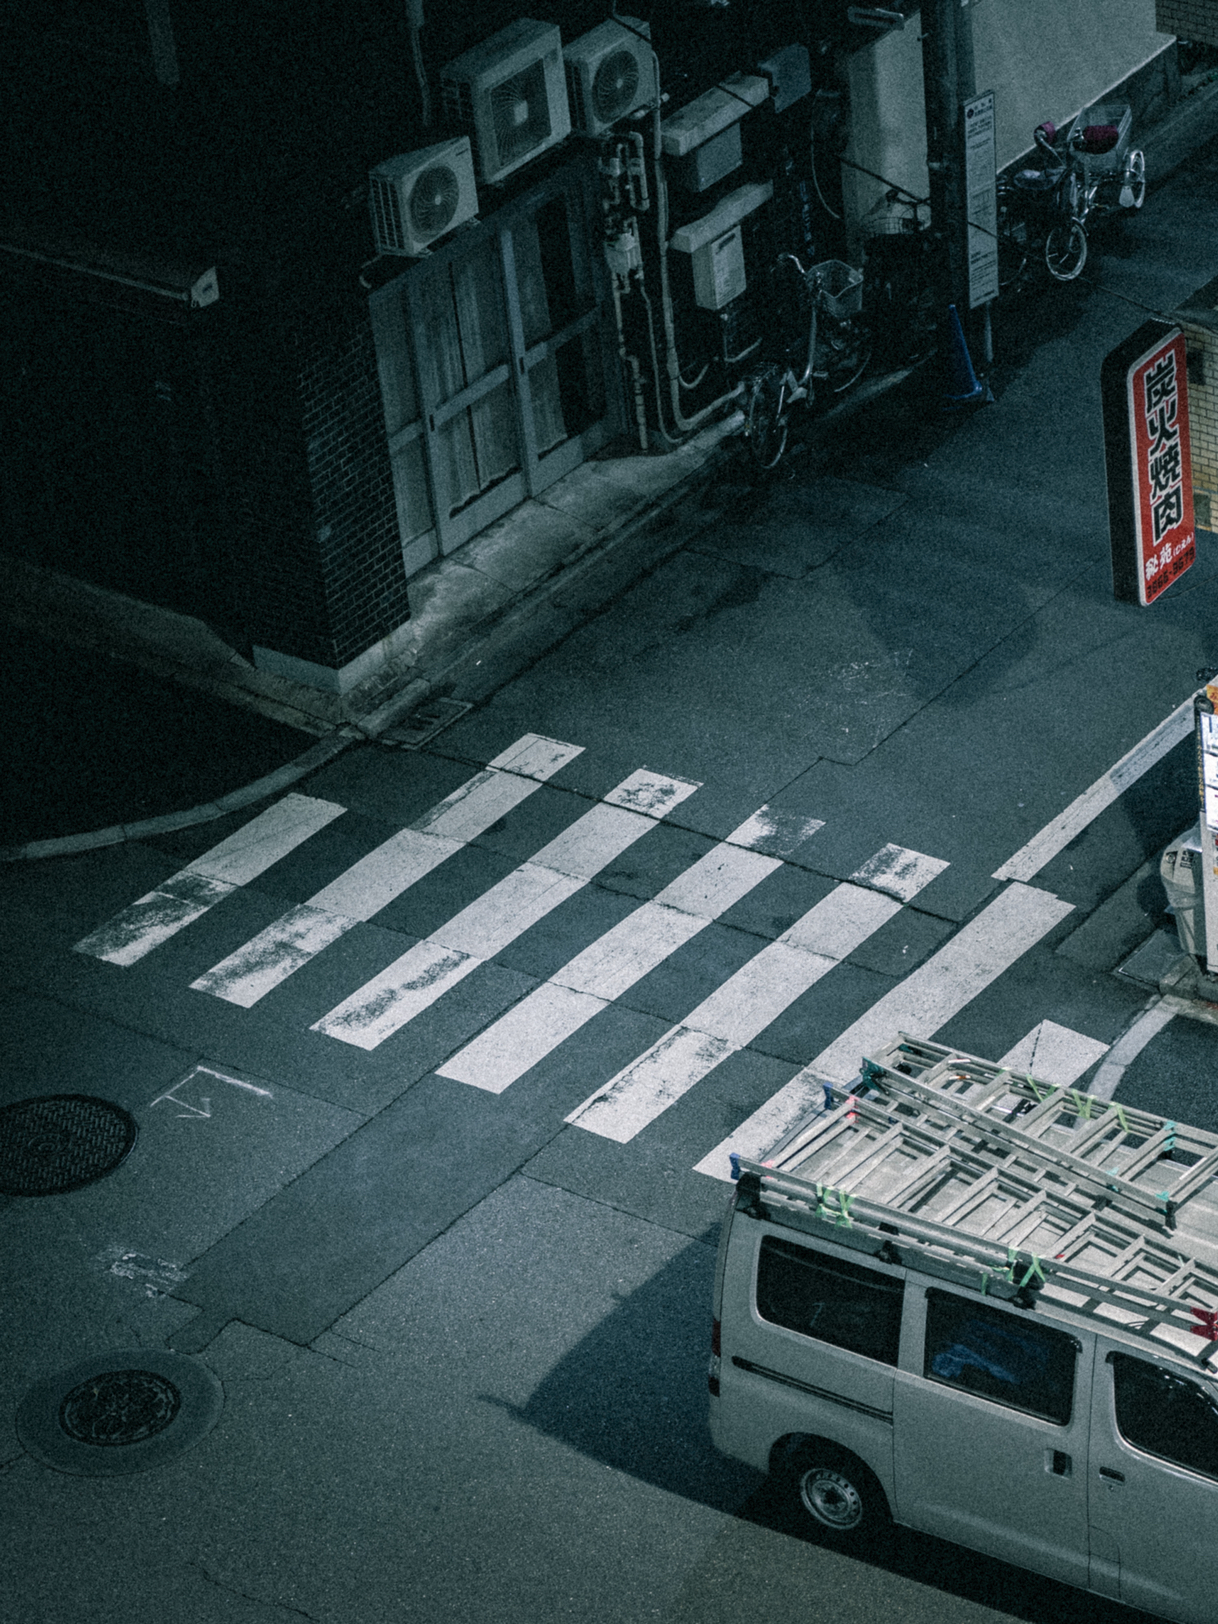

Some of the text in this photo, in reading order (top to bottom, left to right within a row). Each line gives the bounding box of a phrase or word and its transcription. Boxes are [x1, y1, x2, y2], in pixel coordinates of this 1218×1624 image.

[1144, 349, 1183, 547] 炭火焼肉
[1147, 546, 1195, 600] 3866-9679
